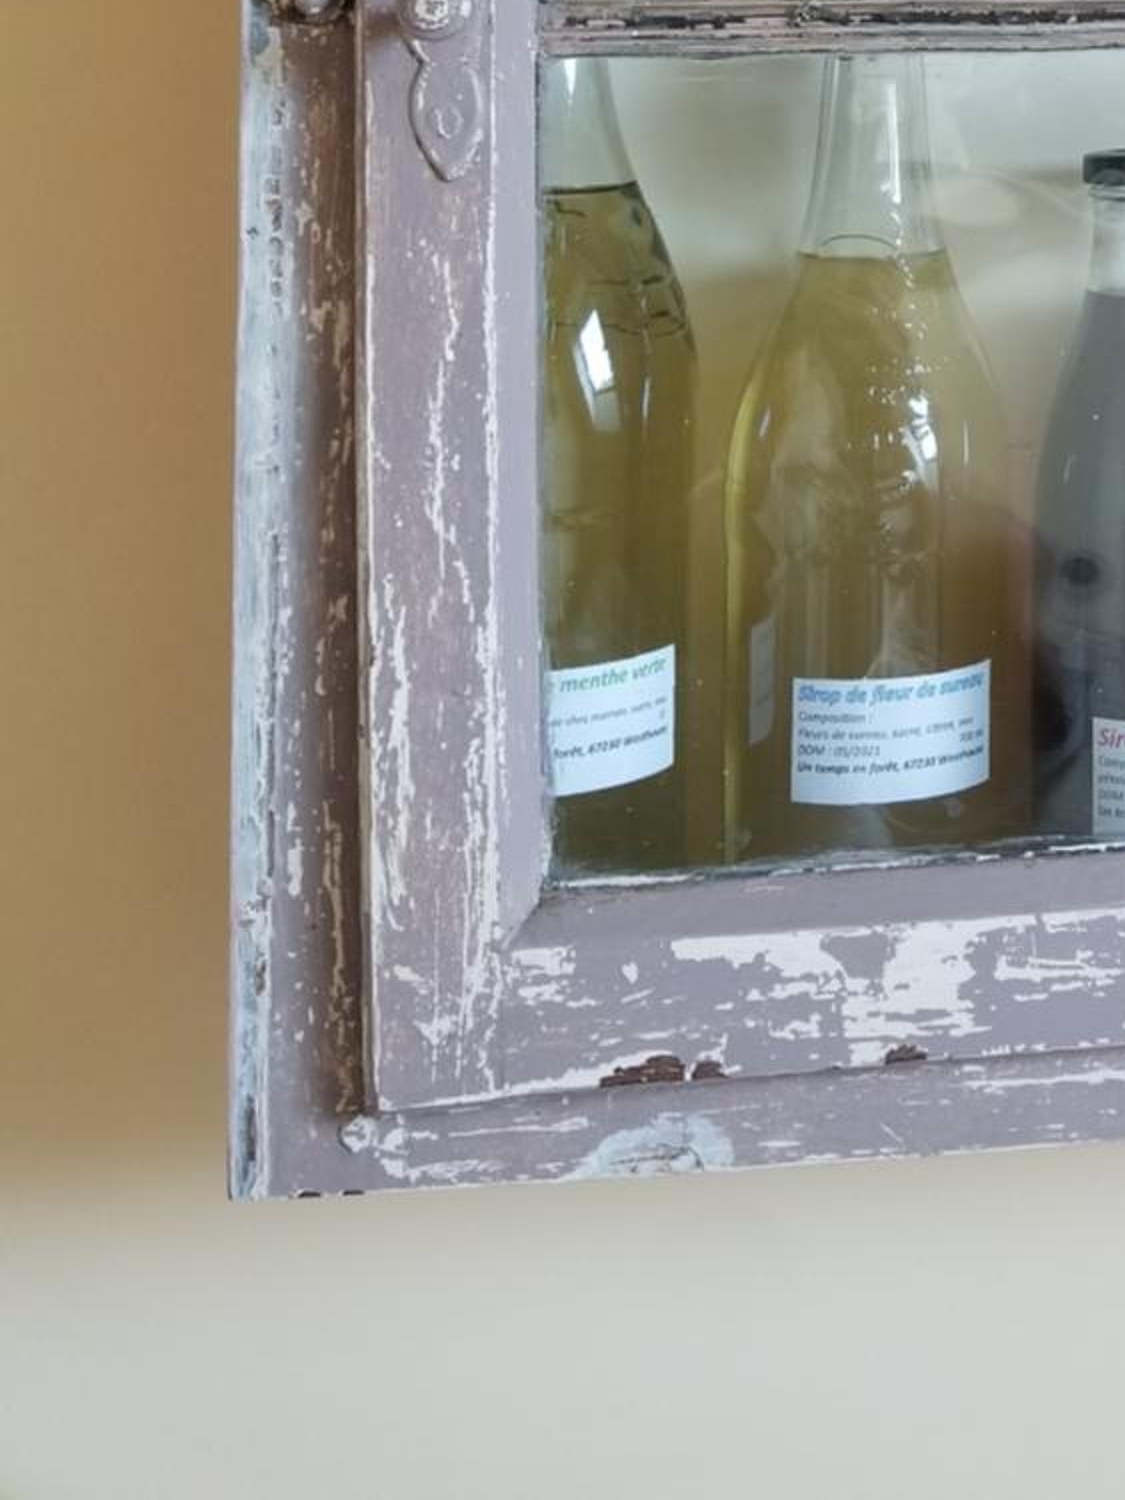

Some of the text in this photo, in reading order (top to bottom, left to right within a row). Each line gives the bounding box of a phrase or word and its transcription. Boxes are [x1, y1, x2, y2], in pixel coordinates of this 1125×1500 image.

[560, 668, 628, 693] menthe
[799, 683, 842, 706] Sirop
[846, 684, 867, 703] de
